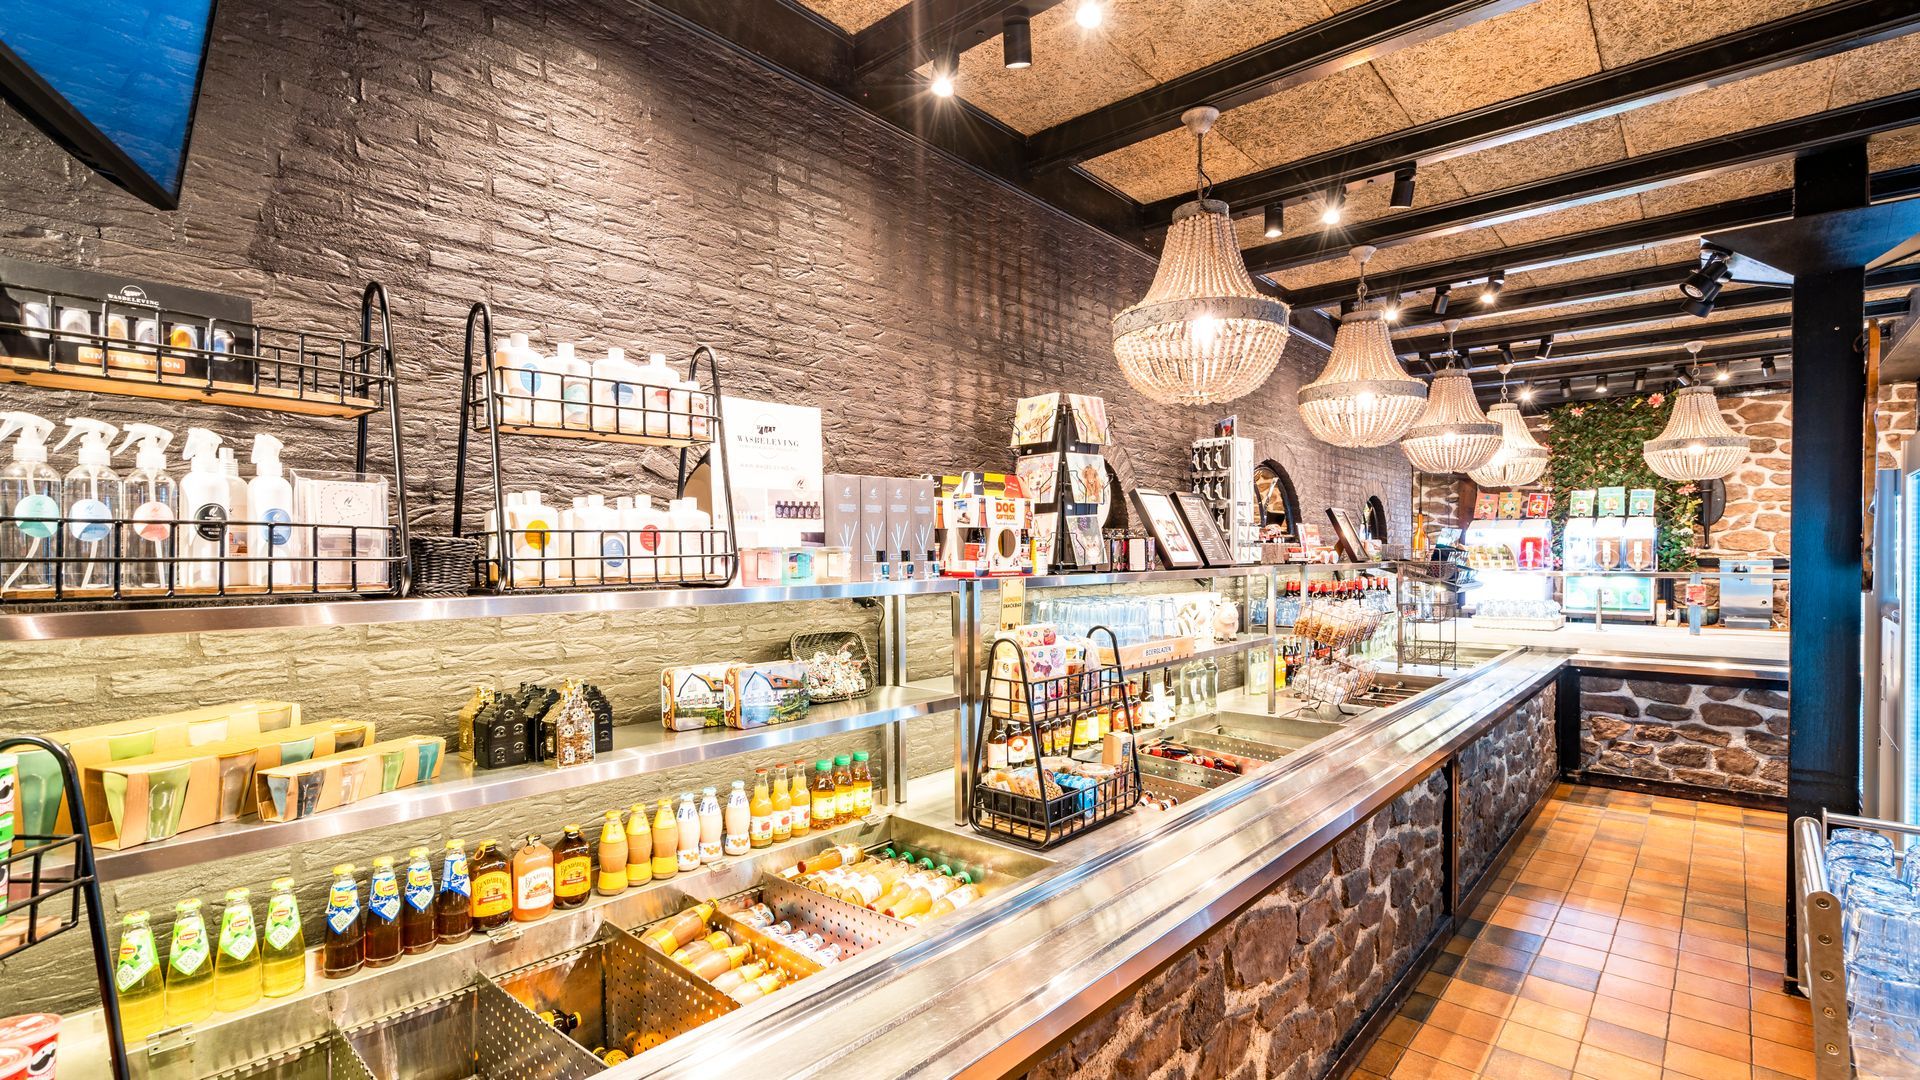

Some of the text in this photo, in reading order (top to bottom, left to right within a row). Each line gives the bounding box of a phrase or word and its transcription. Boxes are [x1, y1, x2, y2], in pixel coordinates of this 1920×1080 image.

[84, 351, 181, 369] LIMTED EDITON
[737, 434, 799, 447] WASBELEVING
[995, 502, 1015, 513] DOG
